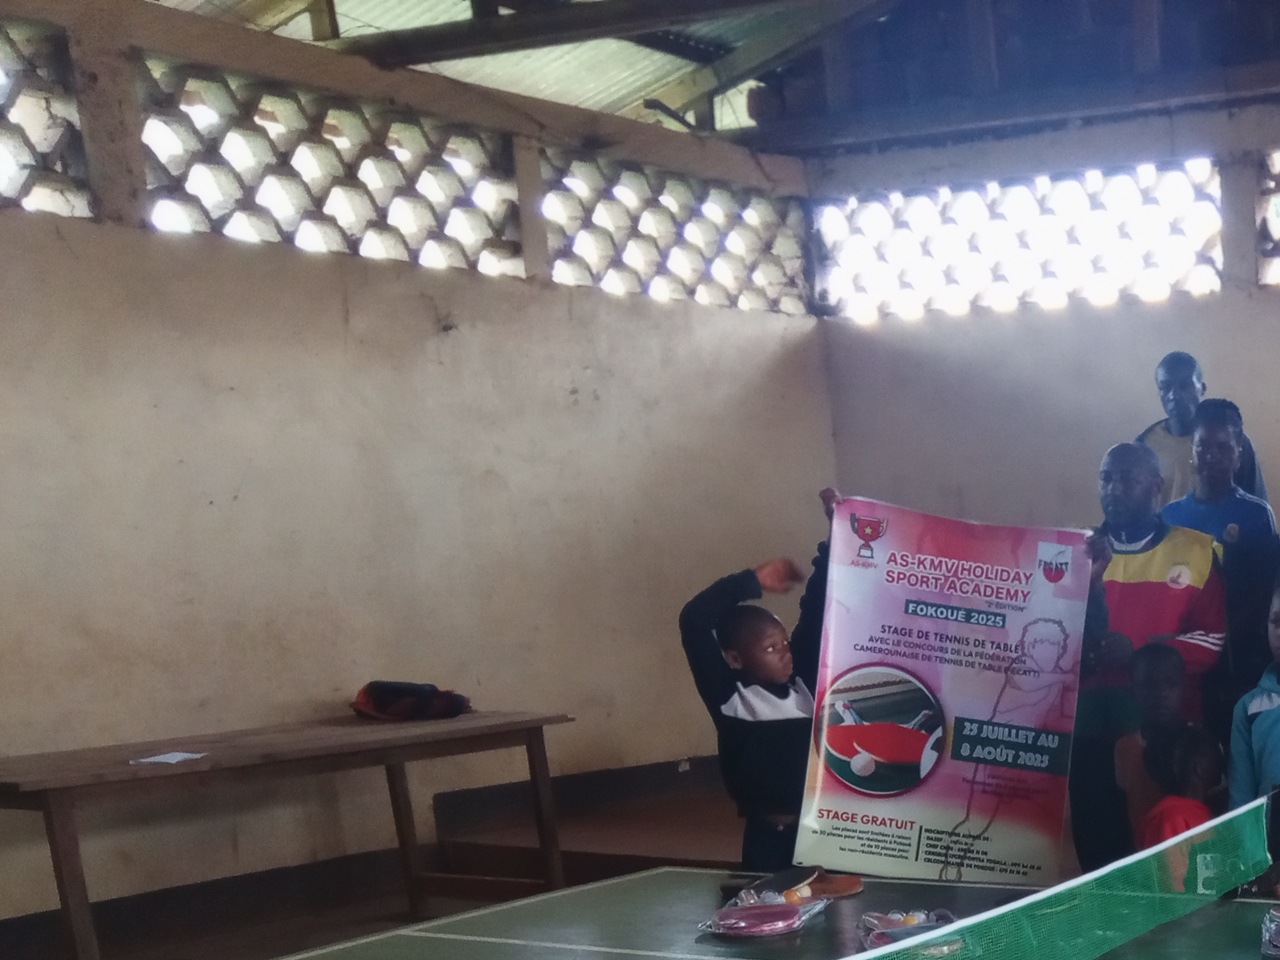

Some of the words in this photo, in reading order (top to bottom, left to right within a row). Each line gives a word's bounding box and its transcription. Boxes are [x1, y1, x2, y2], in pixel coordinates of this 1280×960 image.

[885, 552, 957, 575] AS-KMV
[960, 563, 1033, 585] HOLIDAY
[885, 570, 945, 590] SPORT
[947, 580, 1031, 603] ACADEMY
[908, 603, 966, 621] FOKOUÉ
[970, 612, 1003, 627] 2025
[868, 635, 891, 645] AVEC
[892, 639, 902, 647] LE
[903, 641, 949, 654] CONCOURS
[950, 648, 962, 656] DE
[963, 650, 974, 658] LA
[975, 650, 1026, 665] FÉDÉRATION
[881, 625, 913, 638] STAGE
[917, 630, 930, 640] DE
[934, 633, 970, 646] TENNIS
[973, 639, 987, 649] DE
[990, 641, 1020, 654] TABLE
[854, 644, 920, 660] CAMEROUNAISE
[921, 653, 932, 662] DE
[935, 656, 963, 667] TENNIS
[965, 660, 976, 668] DE
[978, 662, 1002, 674] TABLE
[962, 722, 978, 735] 25
[981, 725, 1035, 744] JUILLET
[1037, 734, 1059, 748] AU
[961, 743, 970, 756] 8
[972, 744, 1015, 762] AOÛT
[1017, 751, 1049, 767] 2025
[818, 808, 858, 823] STAGE
[861, 815, 916, 830] GRATUIT
